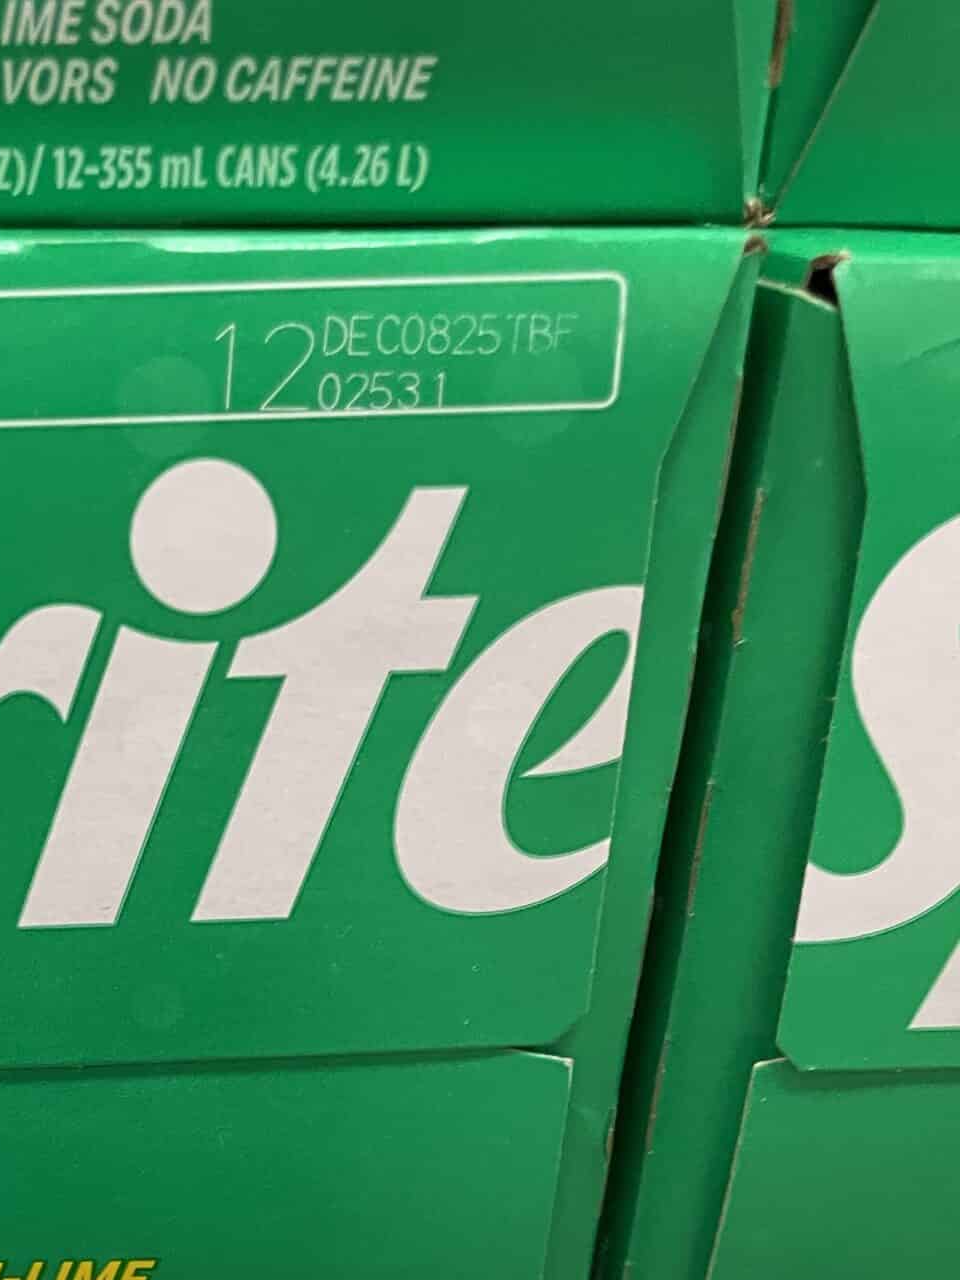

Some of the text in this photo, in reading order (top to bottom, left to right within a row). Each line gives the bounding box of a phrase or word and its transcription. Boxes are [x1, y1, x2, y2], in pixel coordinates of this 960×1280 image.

[90, 0, 213, 45] SODA
[149, 56, 218, 104] NO
[224, 55, 438, 103] CAFFEINE
[53, 145, 152, 190] 12-355
[159, 145, 209, 190] mL
[215, 144, 300, 189] CANS
[304, 144, 390, 193] (4.26
[395, 143, 431, 193] L)
[215, 322, 315, 411] 12
